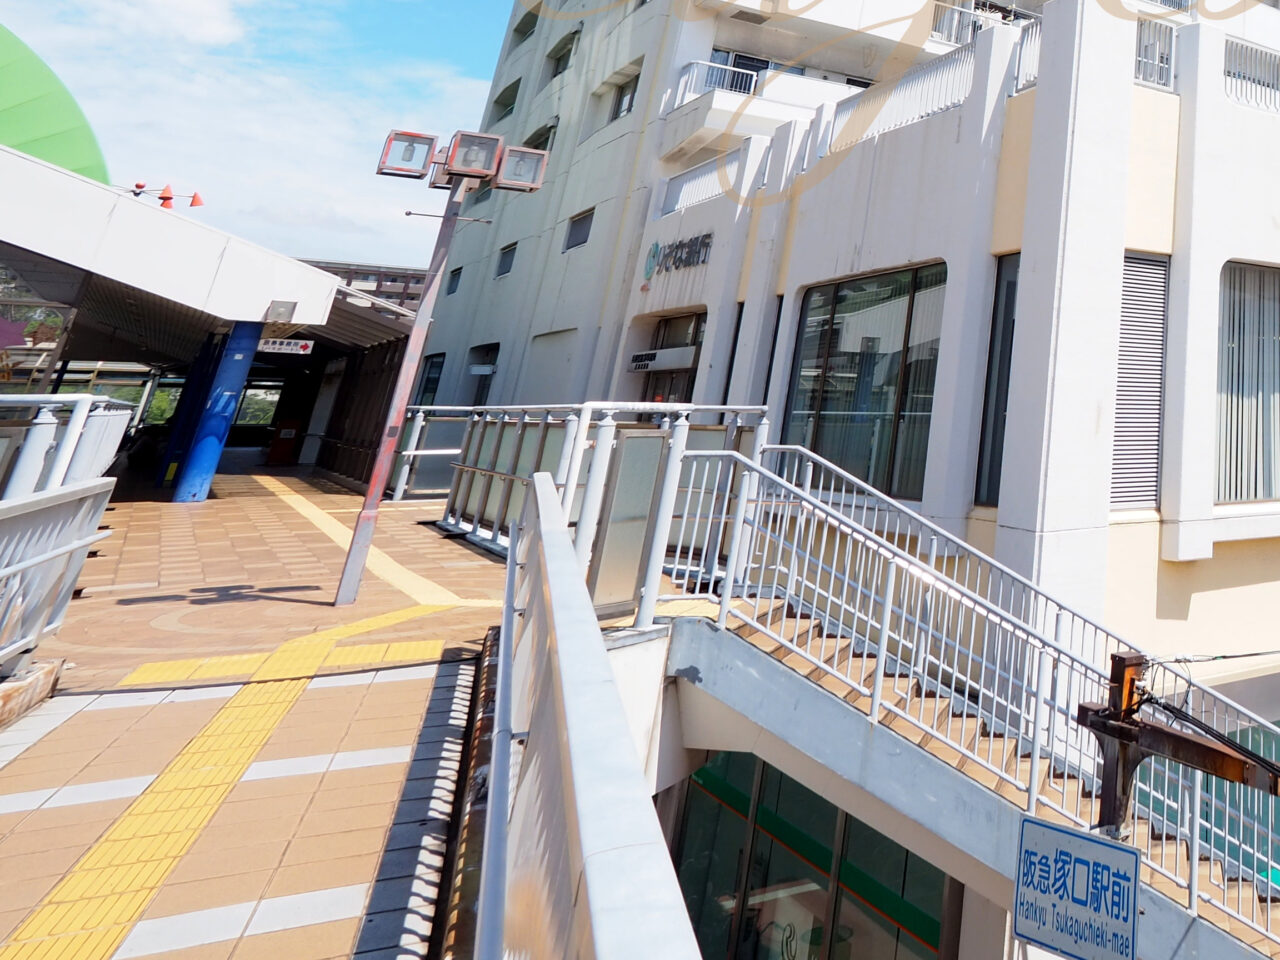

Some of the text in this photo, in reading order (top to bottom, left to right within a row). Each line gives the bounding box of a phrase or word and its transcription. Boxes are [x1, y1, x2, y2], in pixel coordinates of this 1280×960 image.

[1022, 848, 1131, 923] 阪急塚口駅前
[1019, 891, 1130, 958] Hankyu Tsukaguchieki-mae
